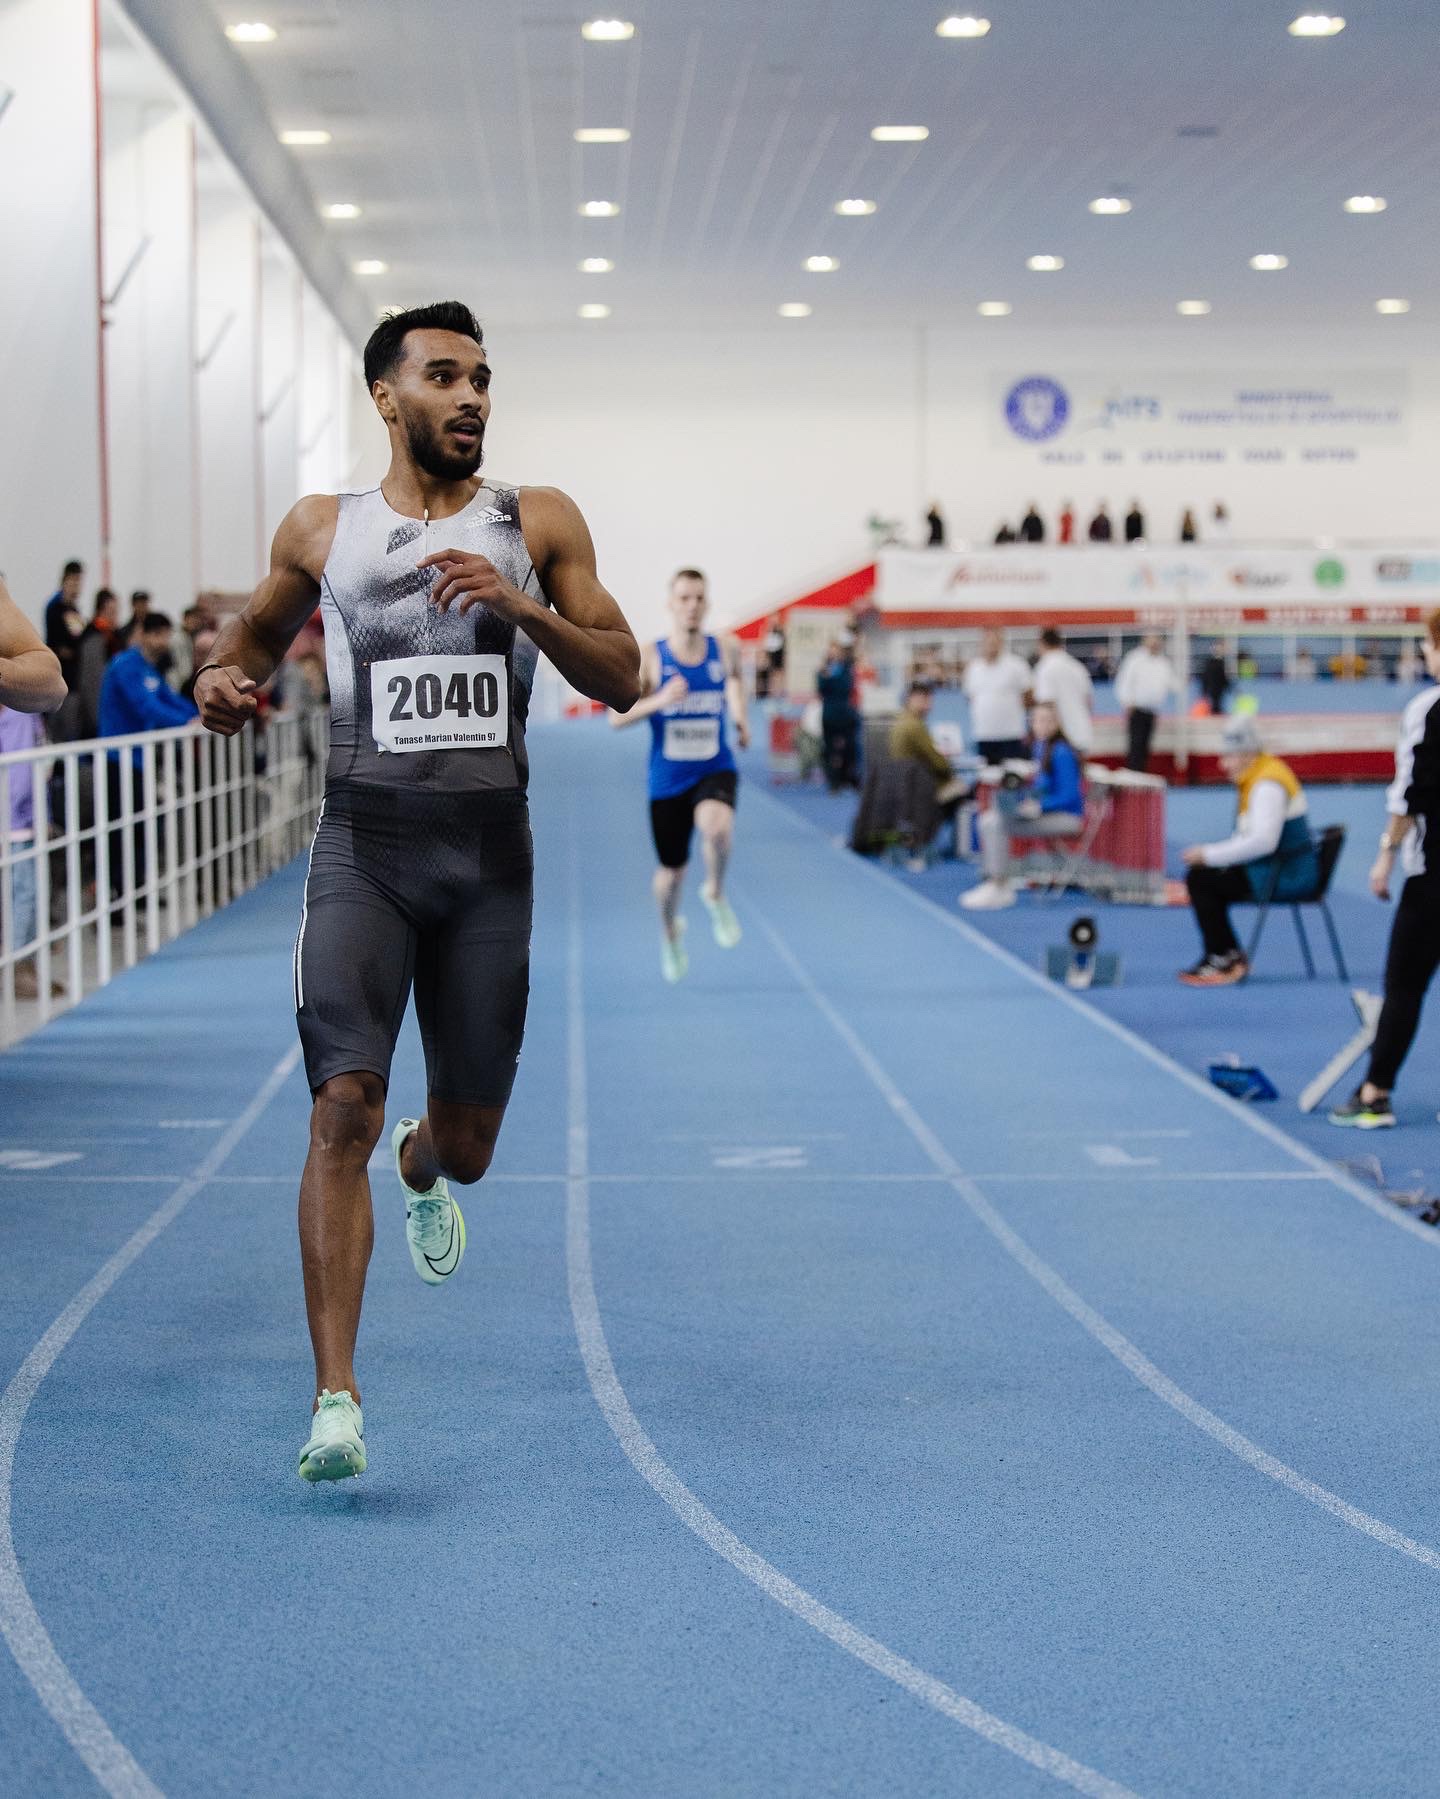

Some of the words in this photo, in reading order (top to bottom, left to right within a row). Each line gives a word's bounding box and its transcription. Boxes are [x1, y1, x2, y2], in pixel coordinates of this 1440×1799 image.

[466, 514, 512, 528] adidas
[387, 672, 499, 722] 2040
[394, 736, 424, 745] Tanase
[424, 734, 452, 743] Marian
[453, 732, 486, 742] Valentin
[487, 732, 496, 741] 97
